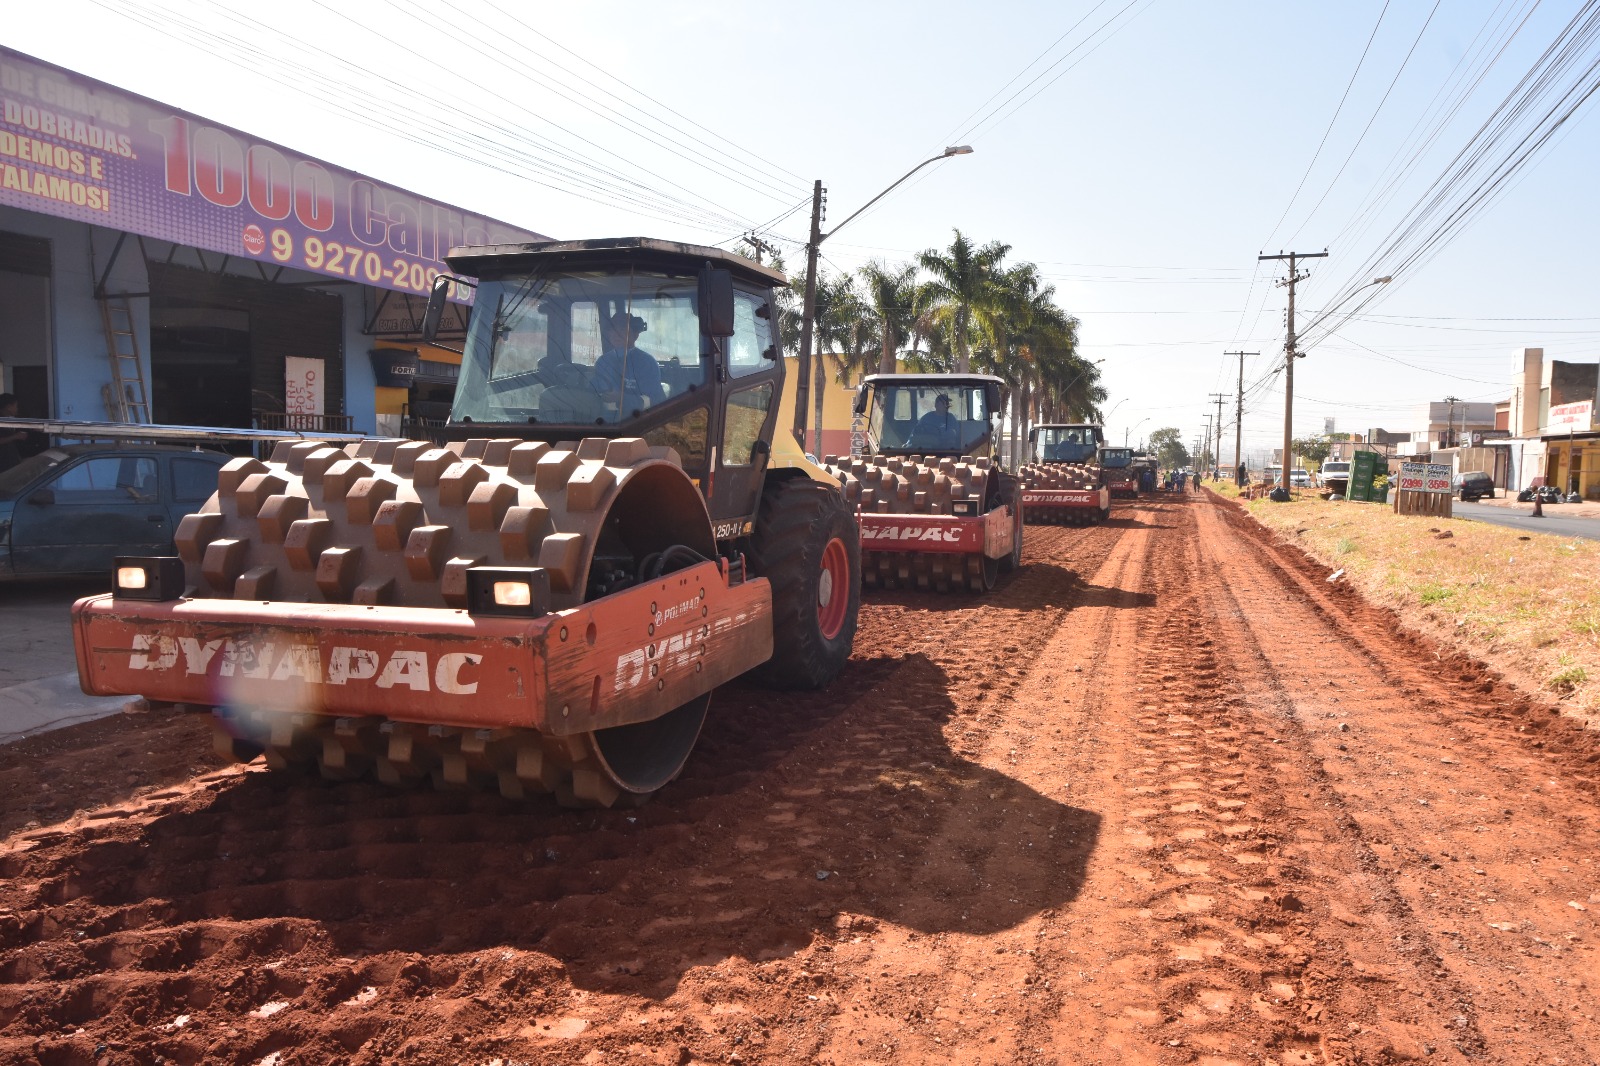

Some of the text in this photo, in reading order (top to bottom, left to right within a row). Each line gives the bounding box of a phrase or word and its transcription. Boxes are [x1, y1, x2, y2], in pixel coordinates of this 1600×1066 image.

[3, 97, 138, 160] DOBRADAS.
[90, 155, 104, 180] E
[148, 115, 333, 232] 1000
[244, 233, 263, 246] Claro
[270, 228, 293, 262] 9
[129, 633, 483, 695] DYNAPAC
